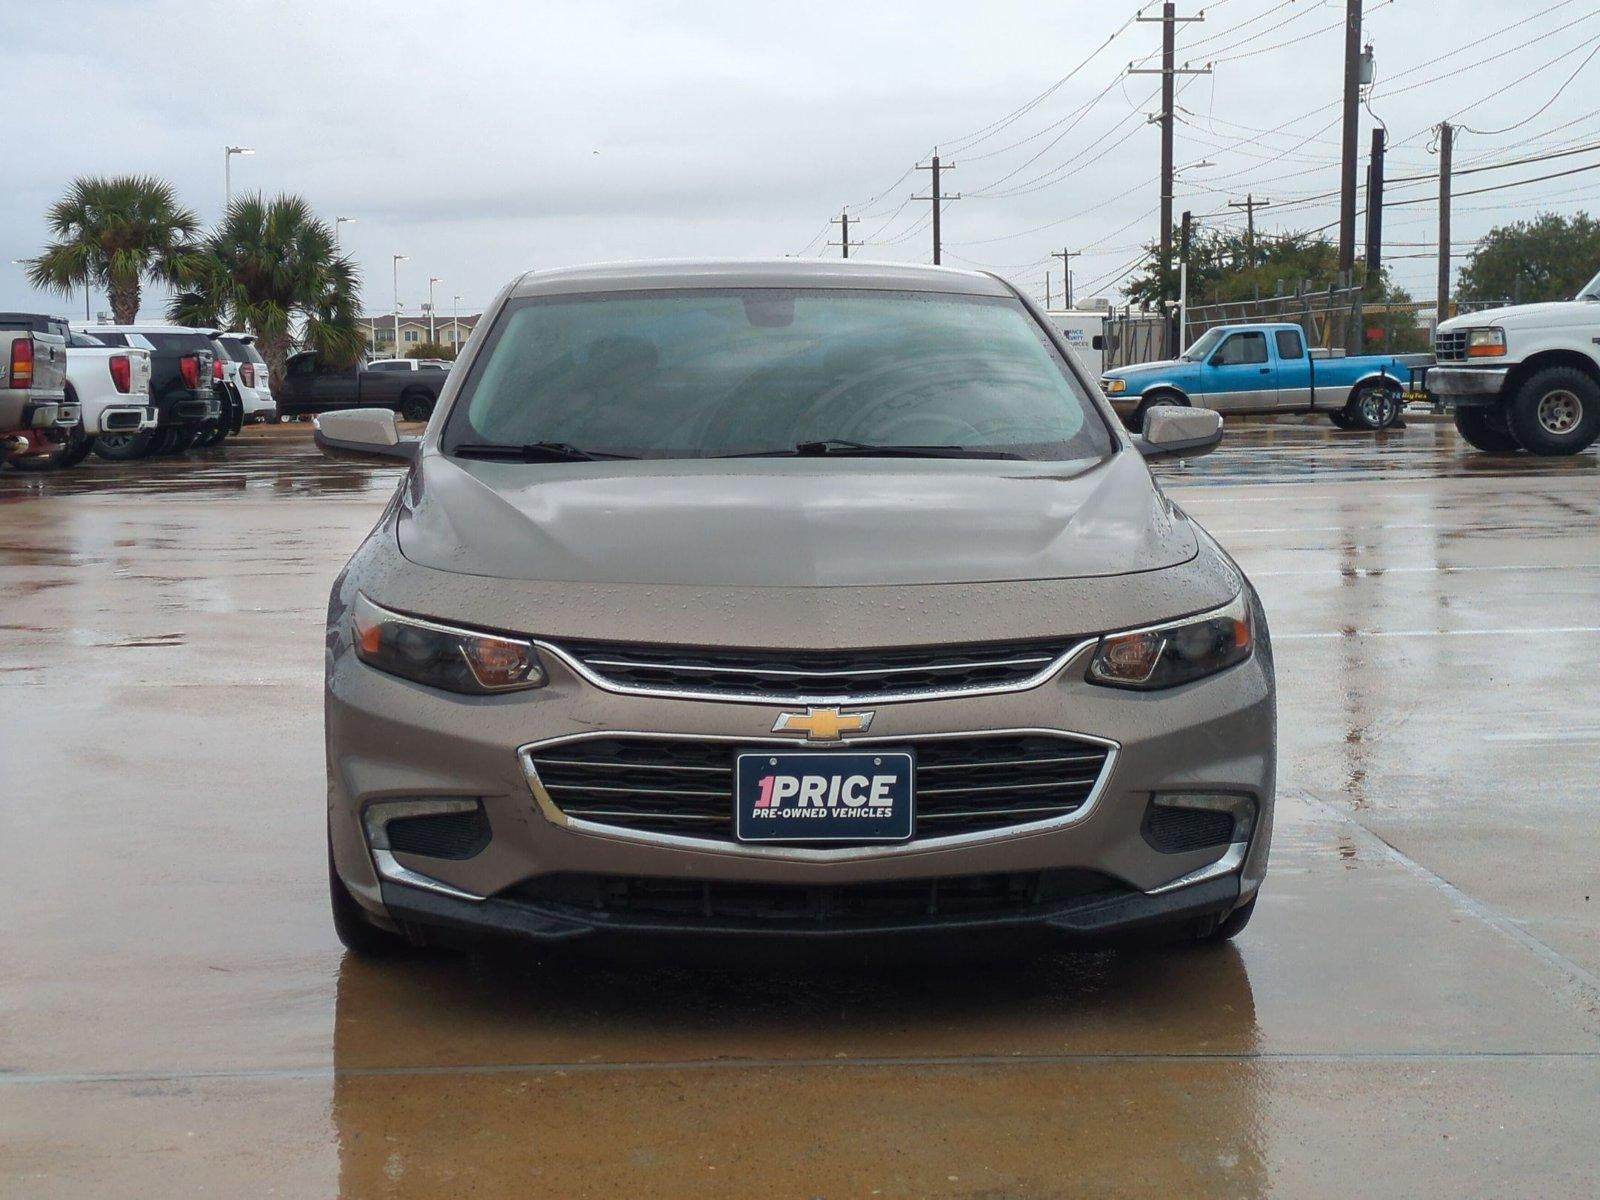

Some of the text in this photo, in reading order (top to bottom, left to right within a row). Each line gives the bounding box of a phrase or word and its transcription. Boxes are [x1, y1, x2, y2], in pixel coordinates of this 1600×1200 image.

[754, 775, 897, 808] 1PRICE
[752, 808, 892, 819] PRE-OWNED VEHICLES
